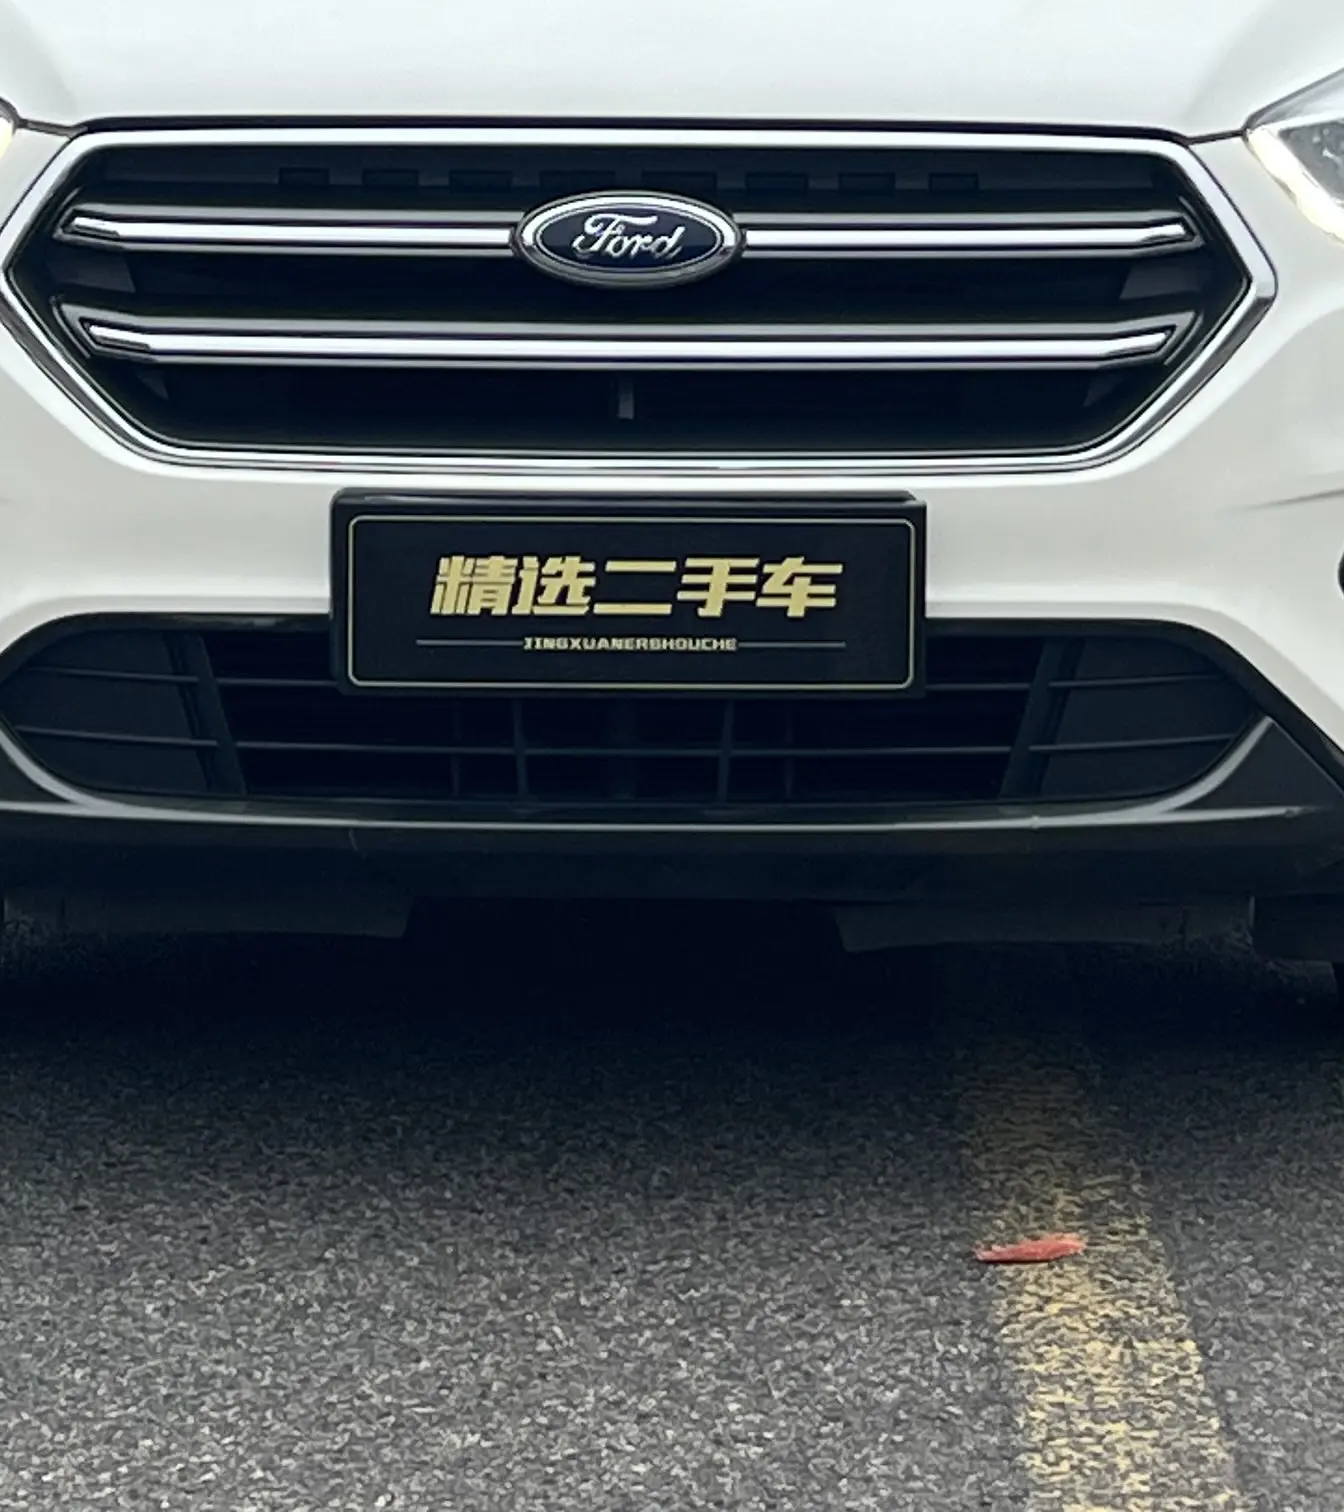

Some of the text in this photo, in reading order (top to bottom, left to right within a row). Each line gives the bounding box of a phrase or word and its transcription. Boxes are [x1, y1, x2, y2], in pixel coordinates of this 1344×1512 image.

[571, 213, 686, 259] Ford
[430, 555, 844, 618] 精选二手车
